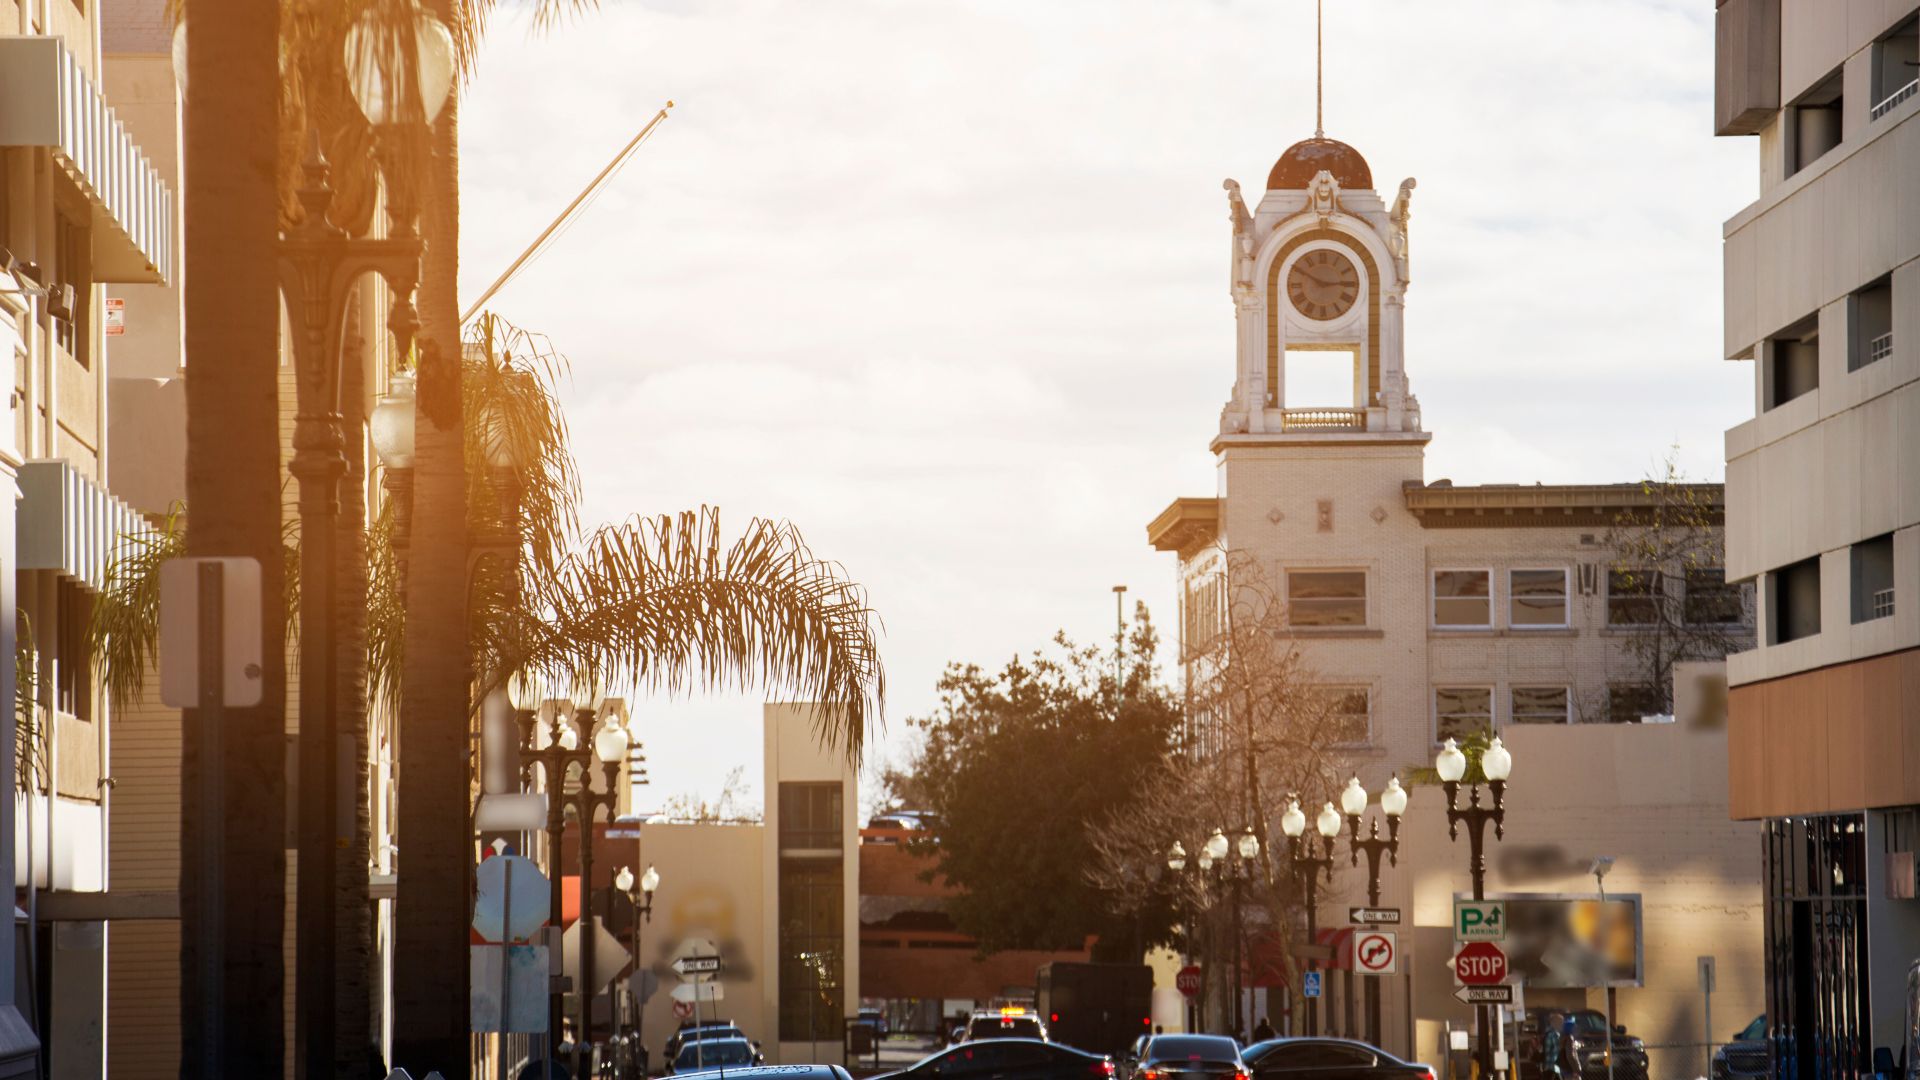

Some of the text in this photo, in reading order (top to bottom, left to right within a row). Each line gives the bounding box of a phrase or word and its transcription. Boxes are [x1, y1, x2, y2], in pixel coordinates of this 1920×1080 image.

[1363, 912, 1397, 921] ONE WAY
[1459, 956, 1503, 976] STOP
[1469, 990, 1506, 999] ONE WAY
